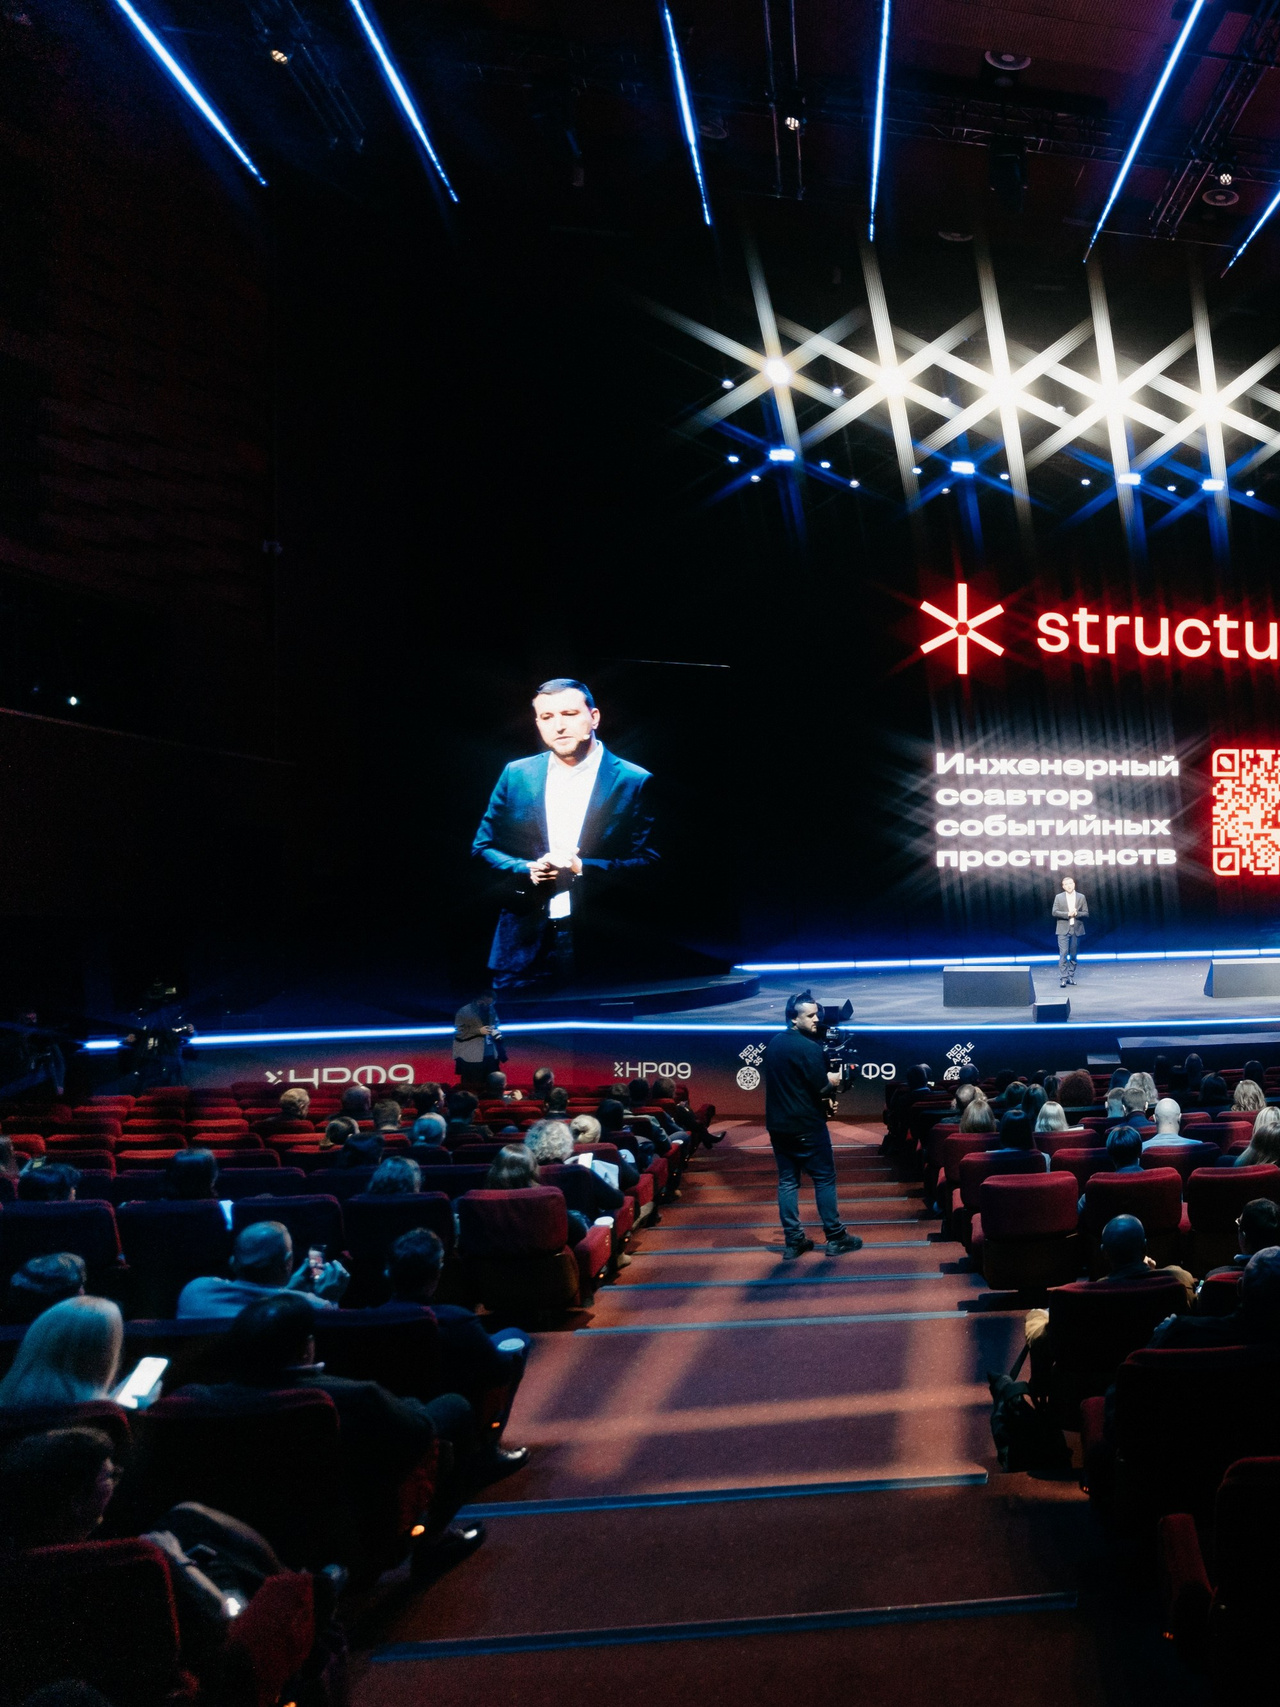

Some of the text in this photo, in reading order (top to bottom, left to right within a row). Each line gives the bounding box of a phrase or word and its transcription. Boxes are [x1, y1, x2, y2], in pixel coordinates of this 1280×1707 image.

[936, 752, 1180, 780] Инженерный
[935, 788, 1094, 811] соавтор
[935, 814, 1172, 837] событийных
[936, 848, 1178, 872] пространств
[738, 1044, 755, 1060] RED
[744, 1042, 767, 1066] APPLE
[753, 1055, 764, 1067] 35
[945, 1043, 962, 1060] RED
[952, 1041, 975, 1065] APPLE
[960, 1054, 972, 1066] 35
[625, 1061, 692, 1079] НРФ9
